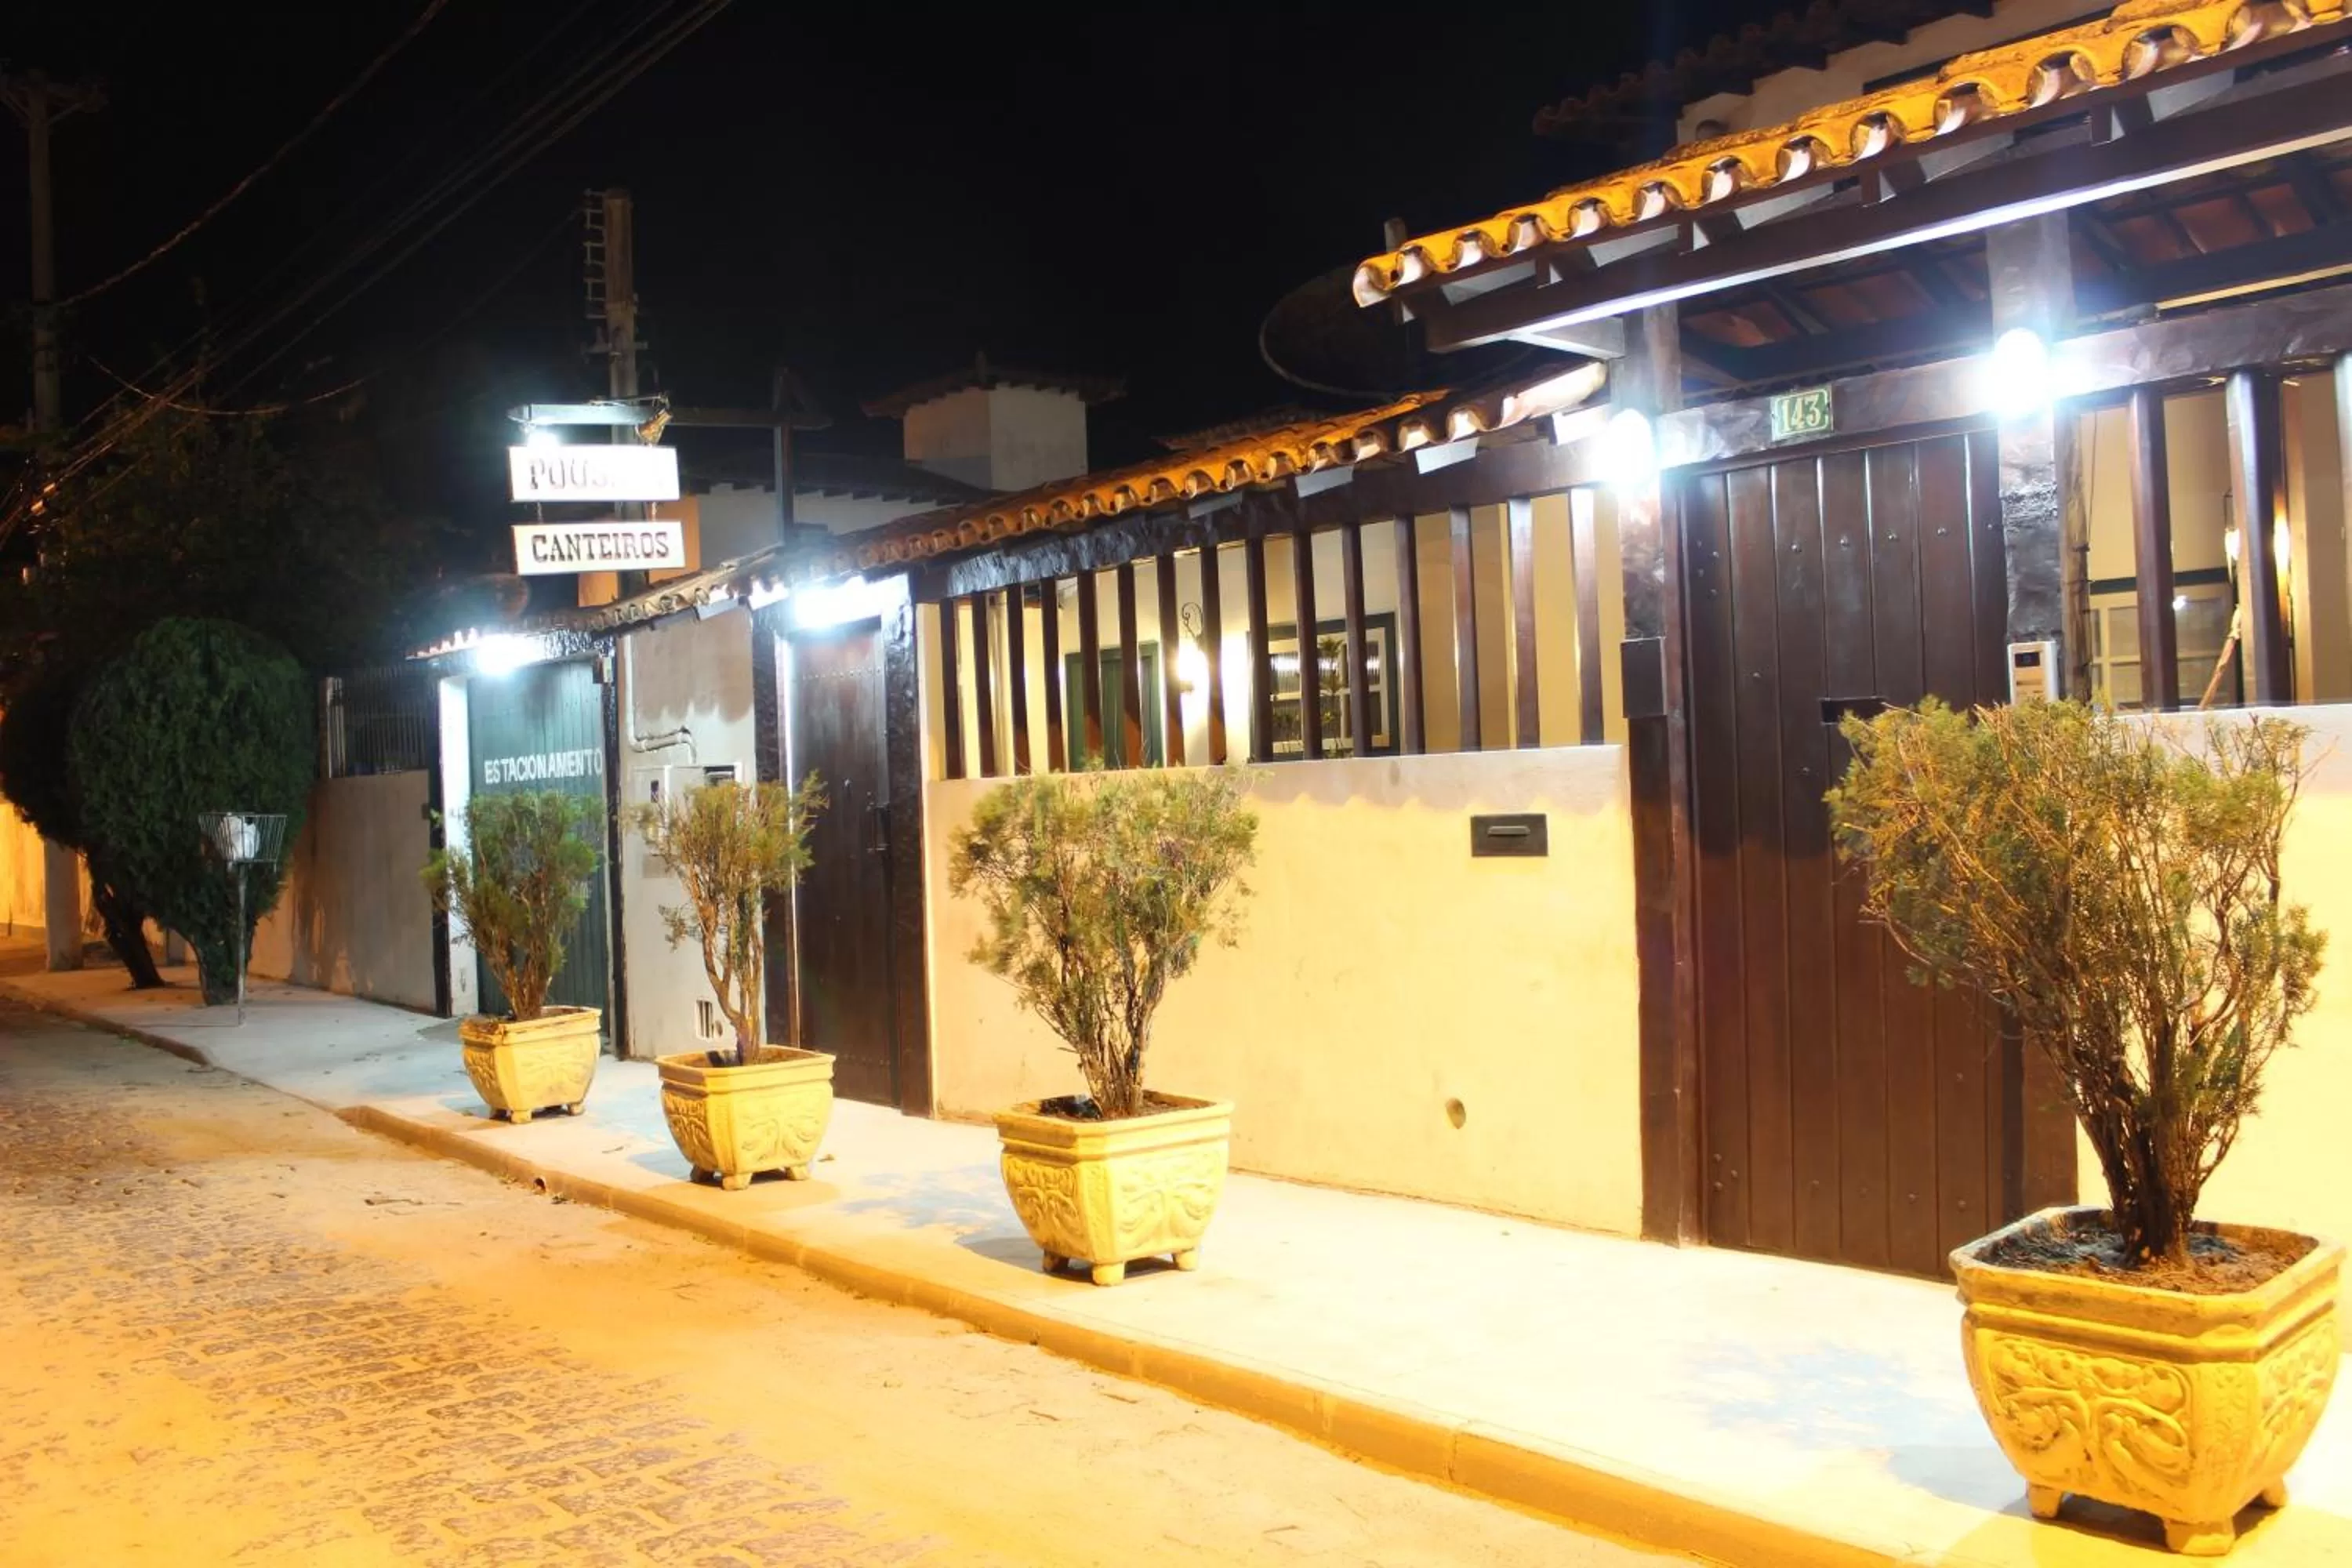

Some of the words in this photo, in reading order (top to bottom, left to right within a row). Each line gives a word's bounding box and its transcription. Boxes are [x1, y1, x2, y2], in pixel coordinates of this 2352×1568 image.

[1782, 394, 1820, 431] 143
[532, 532, 669, 563] CANTEIROS
[484, 748, 603, 784] ESTACIONAMENTO
